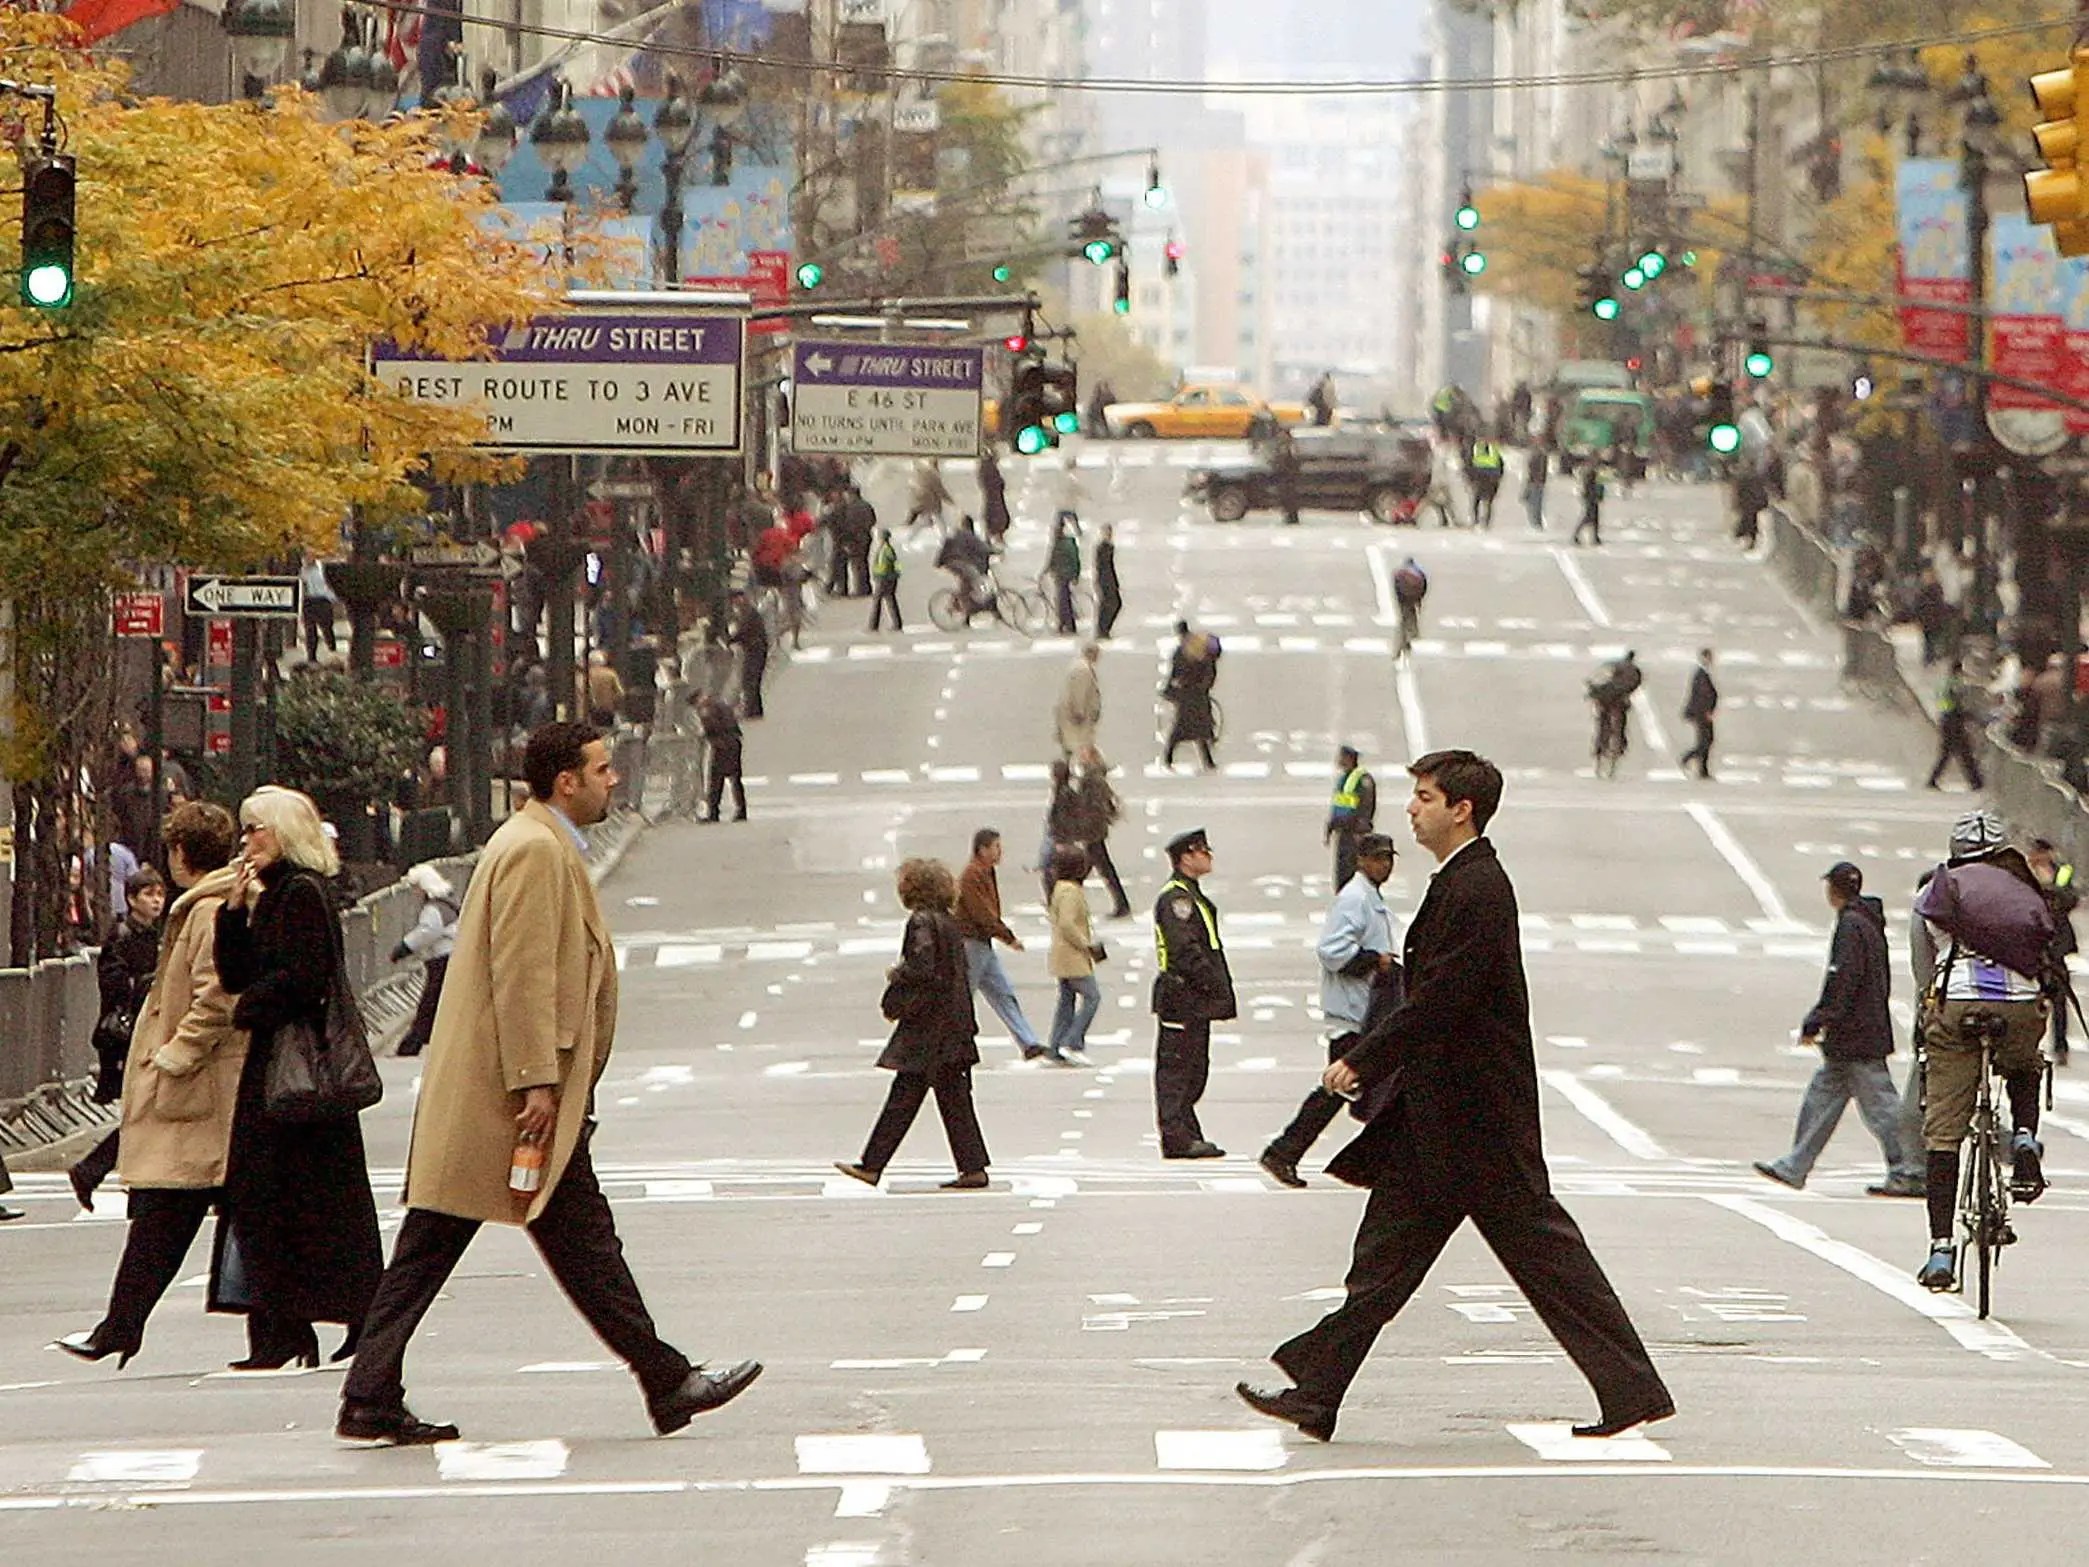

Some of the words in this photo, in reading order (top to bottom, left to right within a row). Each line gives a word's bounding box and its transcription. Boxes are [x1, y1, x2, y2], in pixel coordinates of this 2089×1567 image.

[532, 327, 601, 350] THRU
[609, 327, 705, 351] STREET
[859, 355, 907, 376] THRU
[911, 357, 974, 379] STREET
[398, 377, 463, 399] BEST
[484, 378, 568, 401] ROUTE
[588, 379, 619, 400] TO
[636, 380, 650, 401] 3
[663, 381, 711, 402] AVE
[848, 389, 858, 408] E
[867, 390, 894, 409] 46
[903, 391, 927, 410] ST
[616, 417, 659, 435] MON
[683, 418, 715, 436] FRI
[797, 414, 816, 428] NO
[822, 416, 864, 431] TURNS
[912, 418, 945, 433] PARK
[952, 420, 974, 435] AVE
[204, 588, 233, 601] ONE
[250, 588, 287, 601] WAY
